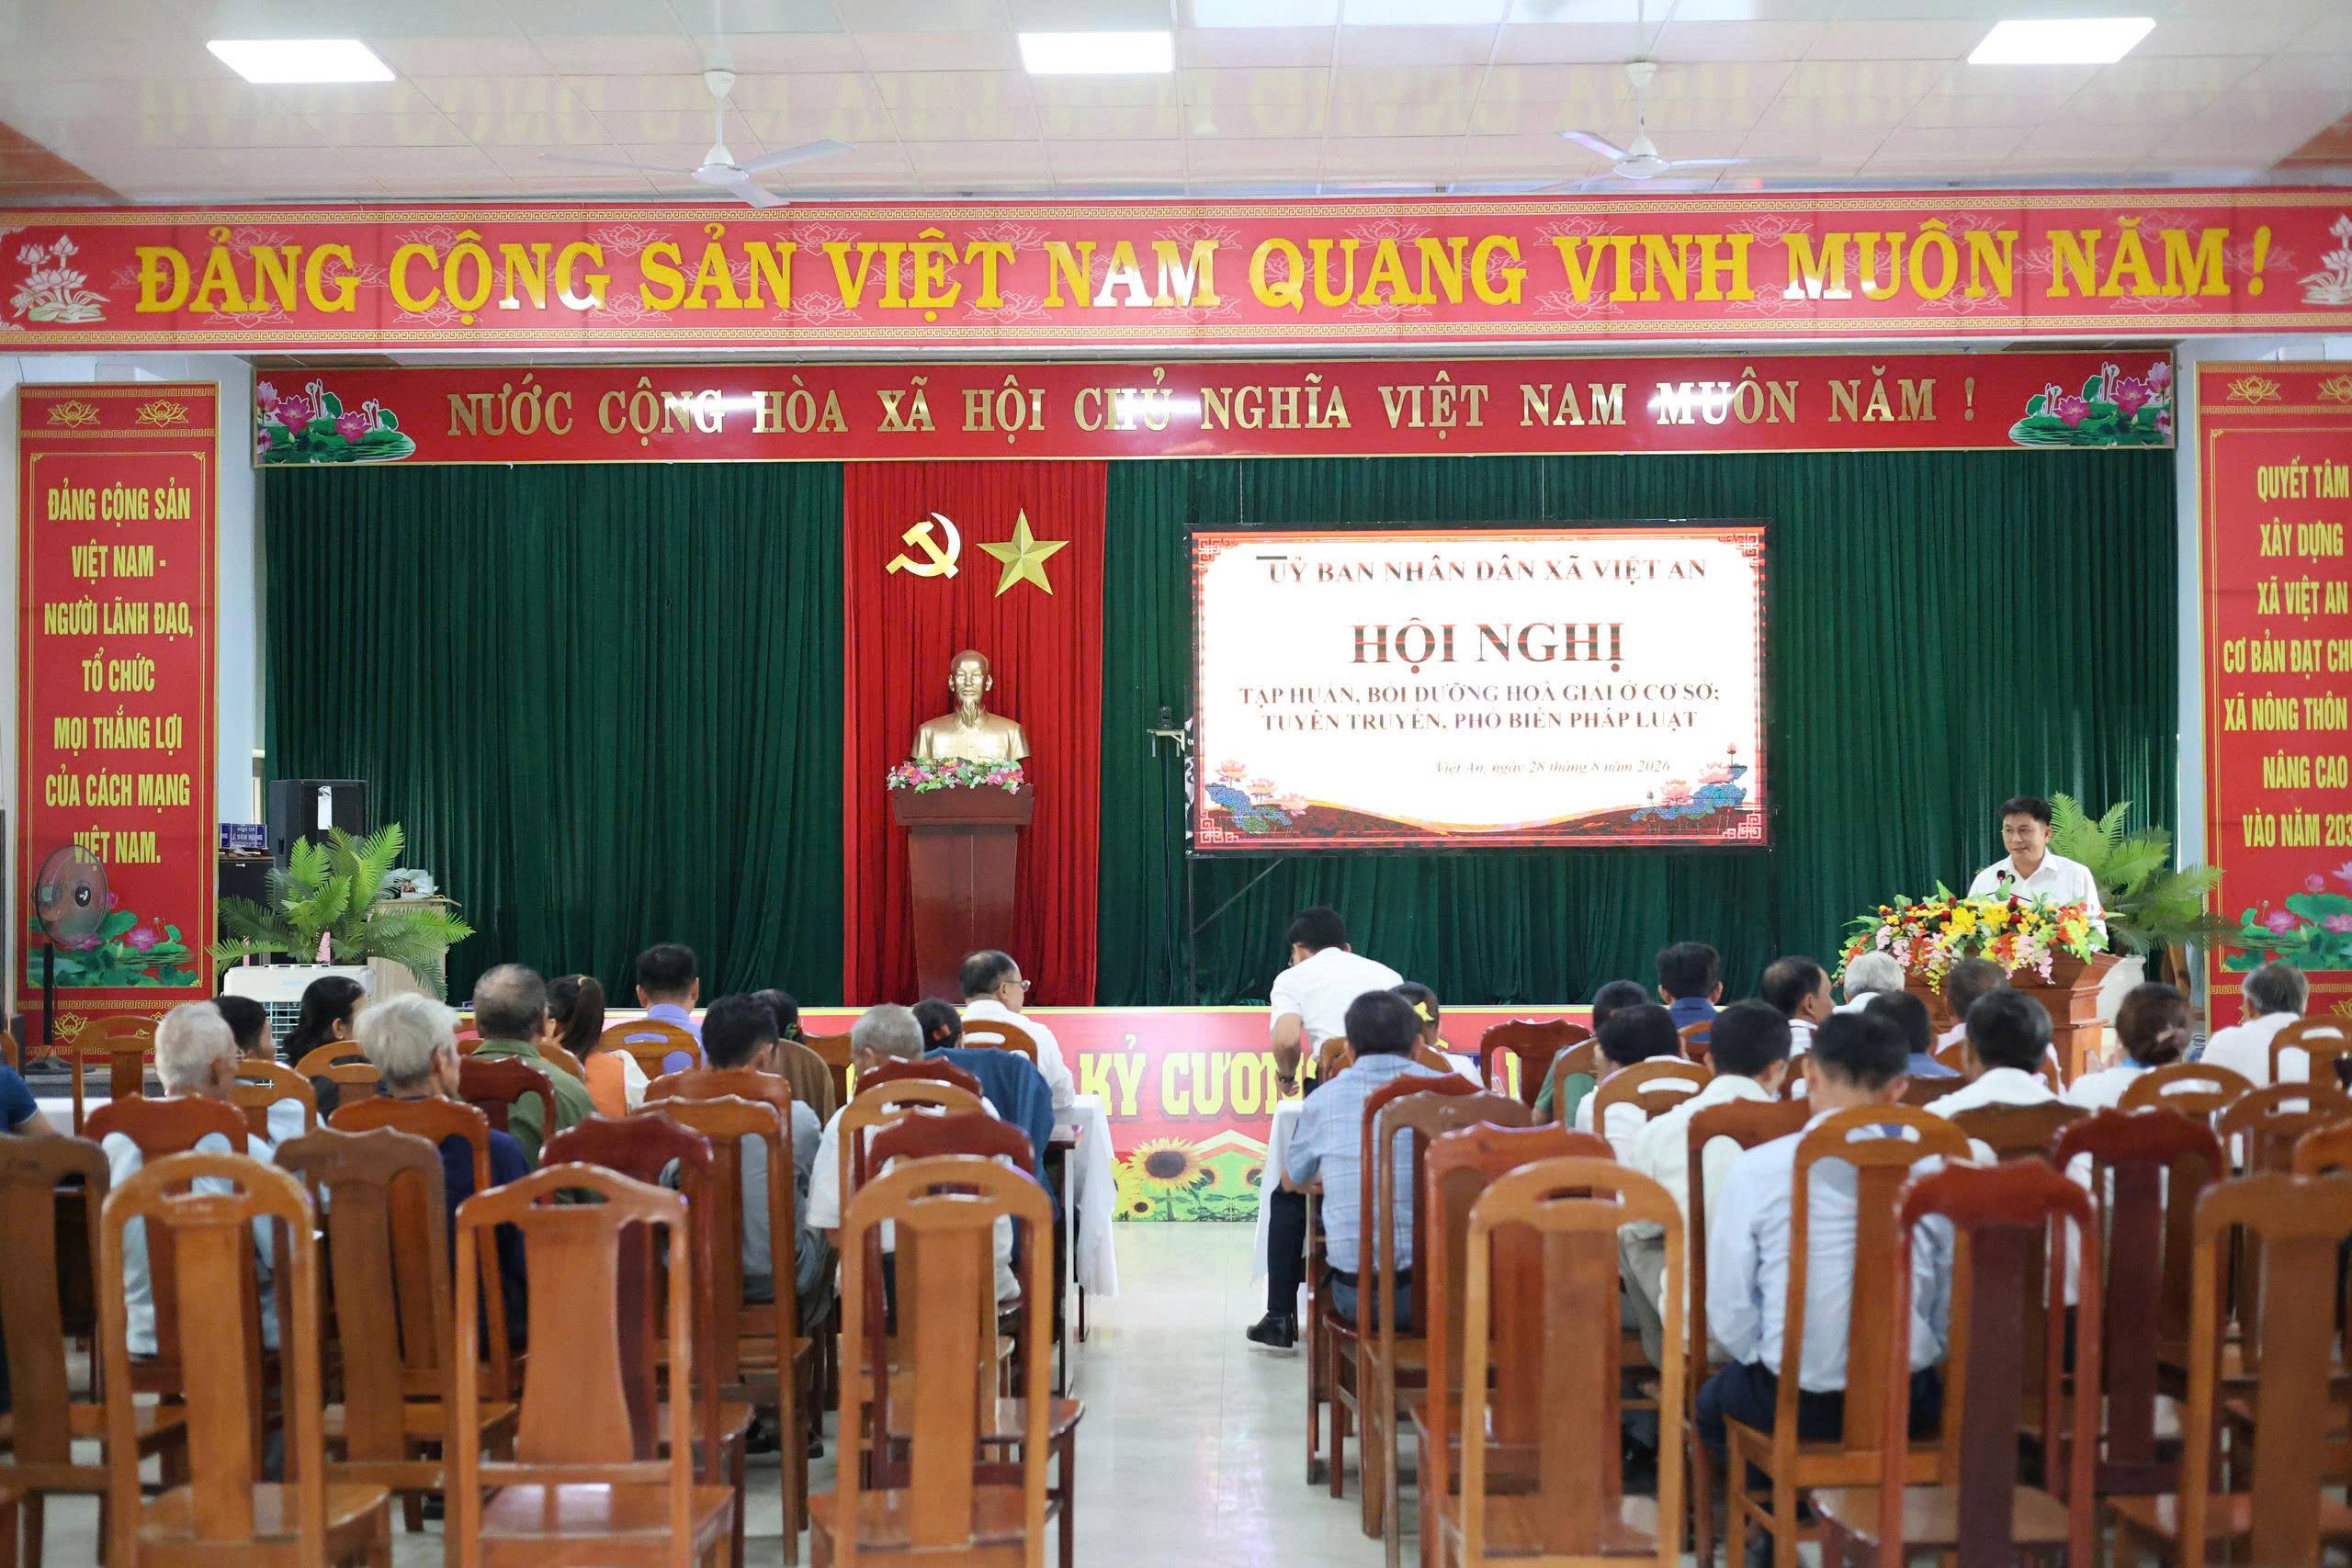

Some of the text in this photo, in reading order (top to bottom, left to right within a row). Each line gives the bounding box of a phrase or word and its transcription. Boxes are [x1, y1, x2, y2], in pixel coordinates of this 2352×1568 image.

[134, 225, 360, 313] ĐẢNG
[389, 230, 611, 325] CỘNG
[639, 223, 796, 310] SẢN
[823, 228, 1014, 323] VIỆT
[1044, 241, 1220, 308] NAM
[1249, 236, 1528, 314] QUANG
[1553, 234, 1755, 301] VINH
[1783, 219, 2018, 300] MUÔN
[2047, 217, 2232, 297] NĂM
[447, 366, 1975, 446] NƯỚC CỘNG HÒA XÃ HỘI CHỦ NGHĨA VIỆT NAM MUÔN NĂM !
[48, 478, 190, 526] ĐẢNG CỘNG SẢN
[2257, 457, 2349, 502] QUYẾT TÂM
[72, 539, 107, 584] VIỆT
[114, 546, 153, 577] NAM
[2260, 517, 2343, 563] XÂY DỰNG
[1317, 561, 1374, 582] BAN
[1385, 555, 1466, 581] NHÂN
[1476, 554, 1535, 581] DÂN
[1544, 554, 1584, 581] XÃ
[1592, 556, 1661, 585] VIỆT
[1668, 558, 1706, 580] AN
[45, 595, 193, 641] NGƯỜI LÃNH ĐẠO,
[2257, 575, 2347, 621] XÃ VIỆT AN
[1350, 616, 1625, 674] HỘI NGHỊ
[2223, 637, 2245, 672] CƠ
[2251, 629, 2285, 672] BẢN
[2290, 639, 2322, 679] ĐẠT
[83, 648, 154, 692] TỔ CHỨC
[54, 705, 182, 756] MỌI THẮNG LỢI
[1570, 705, 1630, 728] PHÁP
[2224, 691, 2347, 730] XÃ NÔNG THÔN
[46, 764, 189, 813] CỦA CÁCH MẠNG
[1637, 761, 1670, 773] 2026
[2264, 750, 2347, 788] NÂNG CAO
[116, 832, 161, 863] NAM.
[2243, 808, 2275, 847] VÀO
[2281, 807, 2320, 846] NĂM
[1079, 1034, 1146, 1116] KỶ
